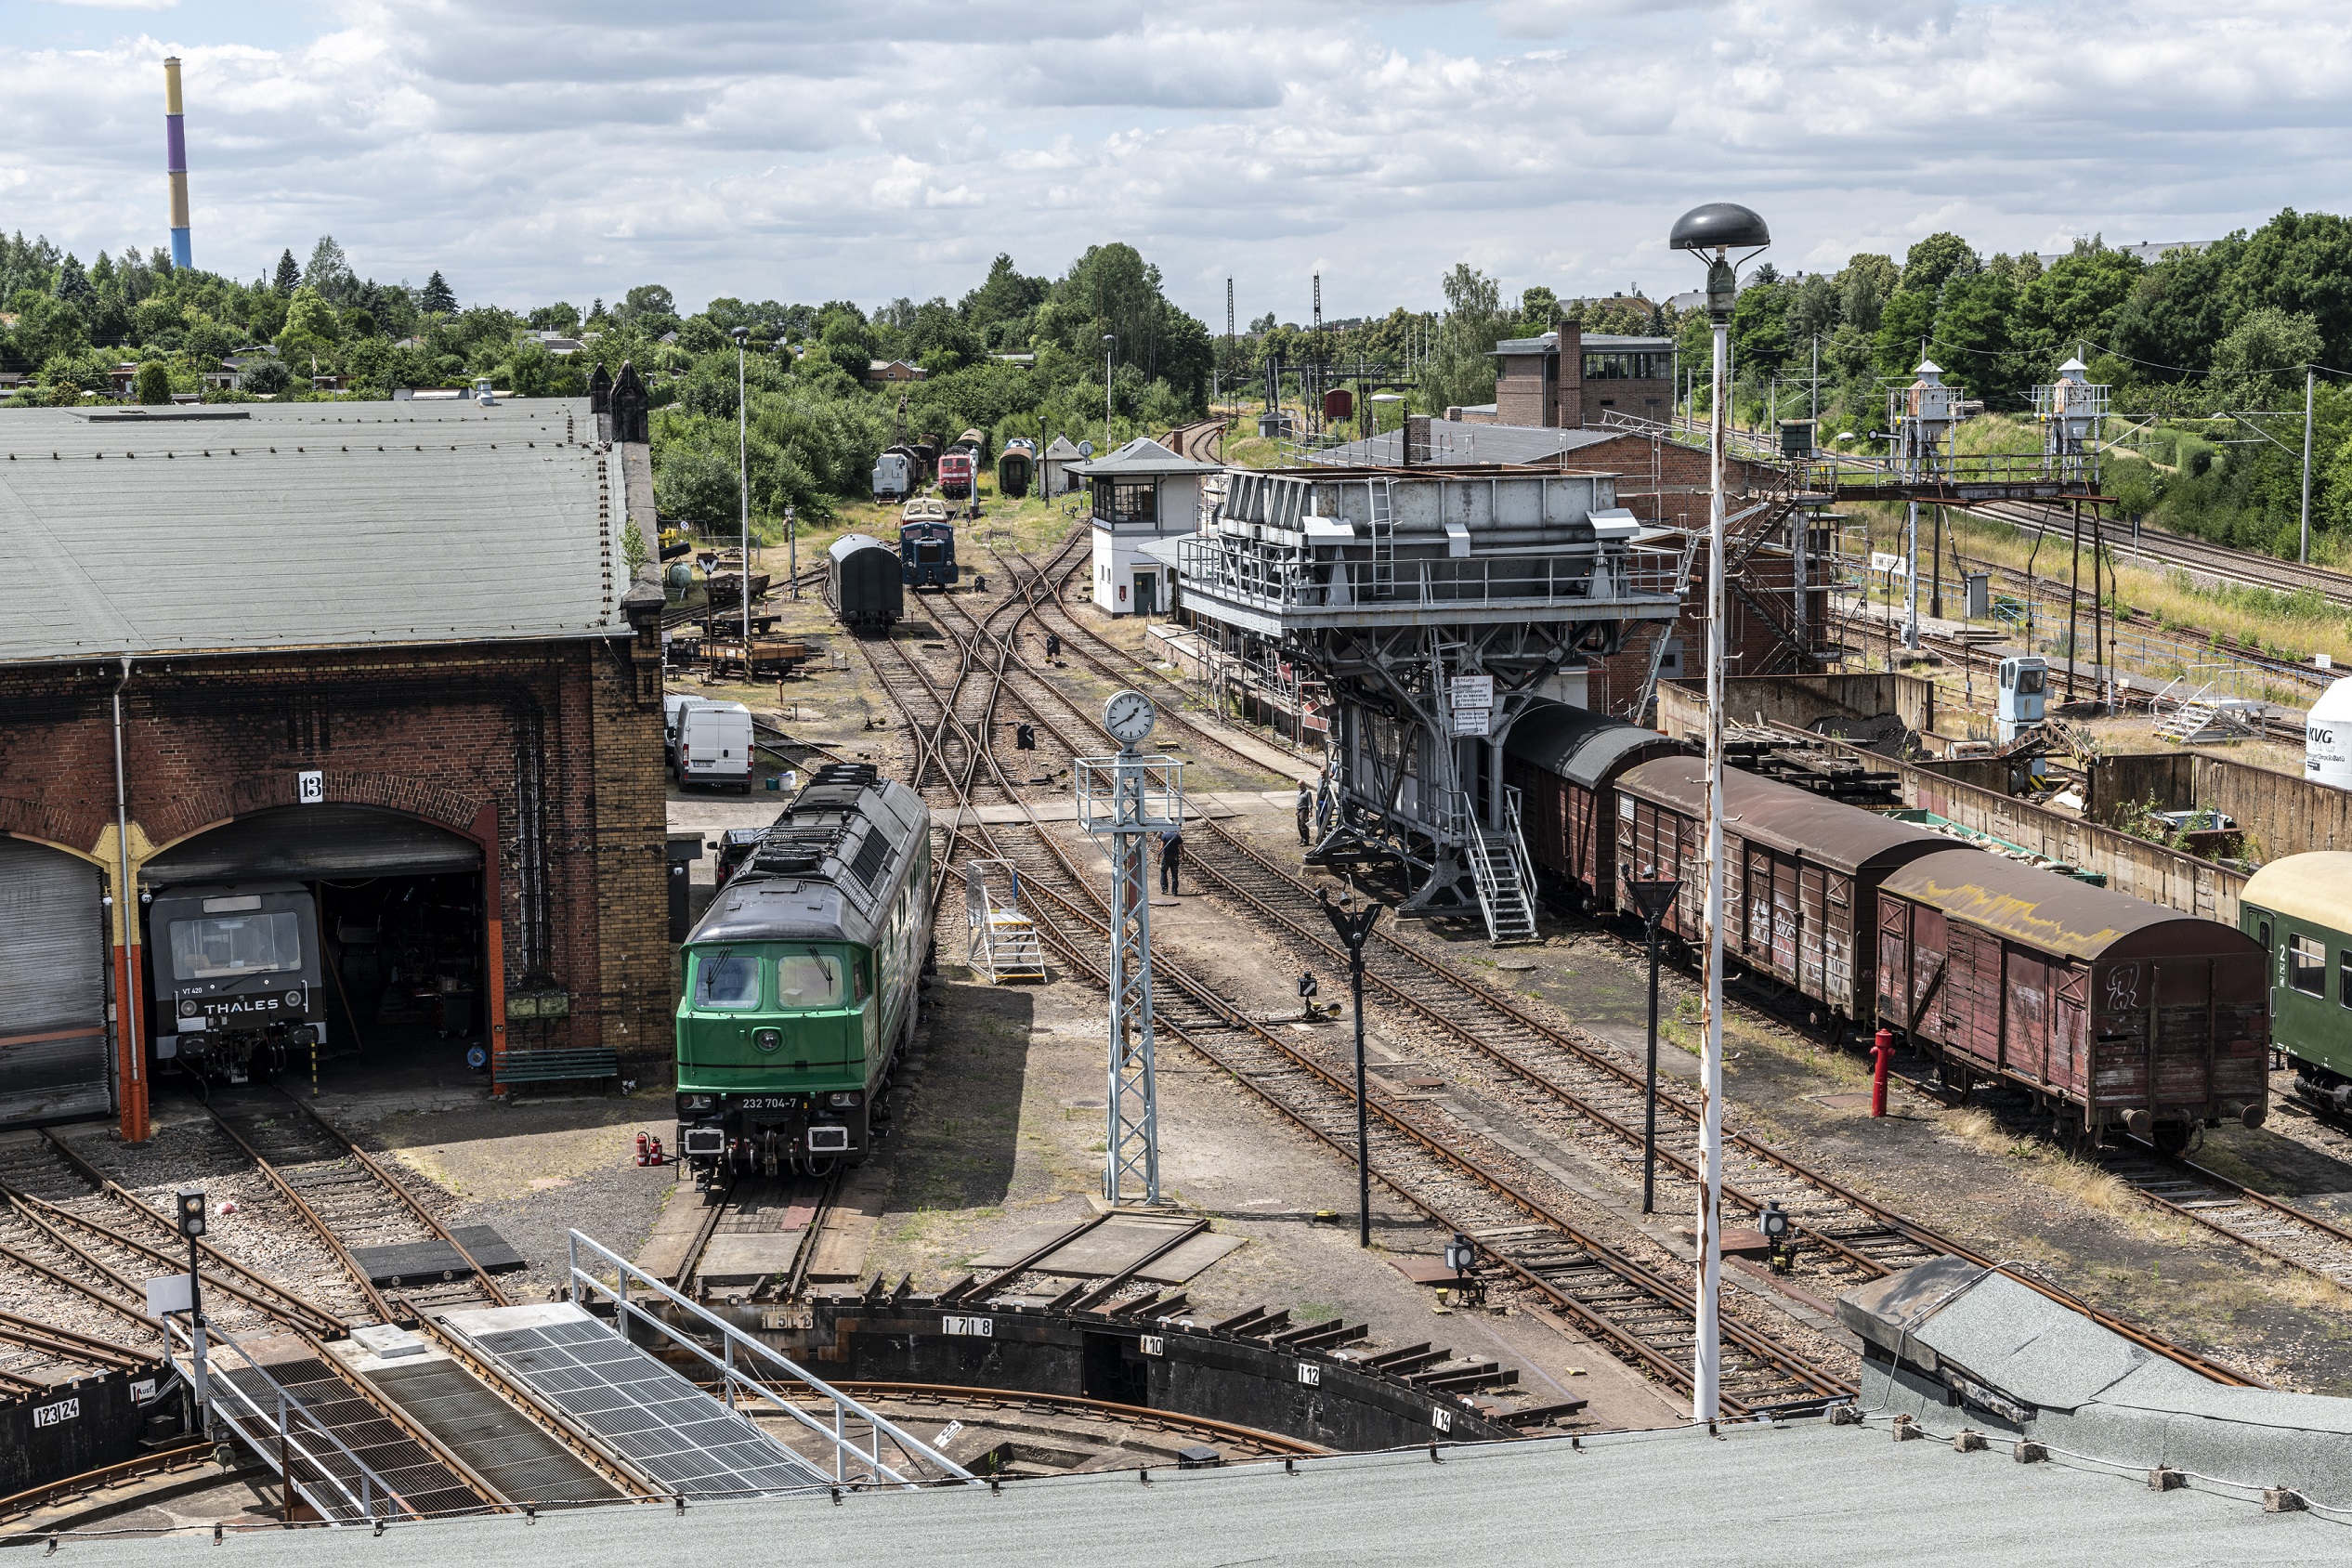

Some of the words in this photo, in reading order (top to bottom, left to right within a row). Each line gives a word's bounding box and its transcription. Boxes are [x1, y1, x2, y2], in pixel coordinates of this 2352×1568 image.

[698, 558, 719, 574] W
[2308, 726, 2333, 744] KVG
[301, 777, 321, 797] 13
[2280, 944, 2285, 962] 2
[203, 999, 279, 1014] THALES
[743, 1098, 763, 1108] 232
[764, 1098, 797, 1108] 704-7
[959, 1319, 966, 1333] 7
[982, 1319, 990, 1335] 8
[1150, 1338, 1162, 1354] 10
[1307, 1367, 1318, 1384] 12
[43, 1406, 58, 1424] 23
[62, 1399, 78, 1418] 24
[1441, 1412, 1450, 1431] 14
[941, 1421, 960, 1440] 50
